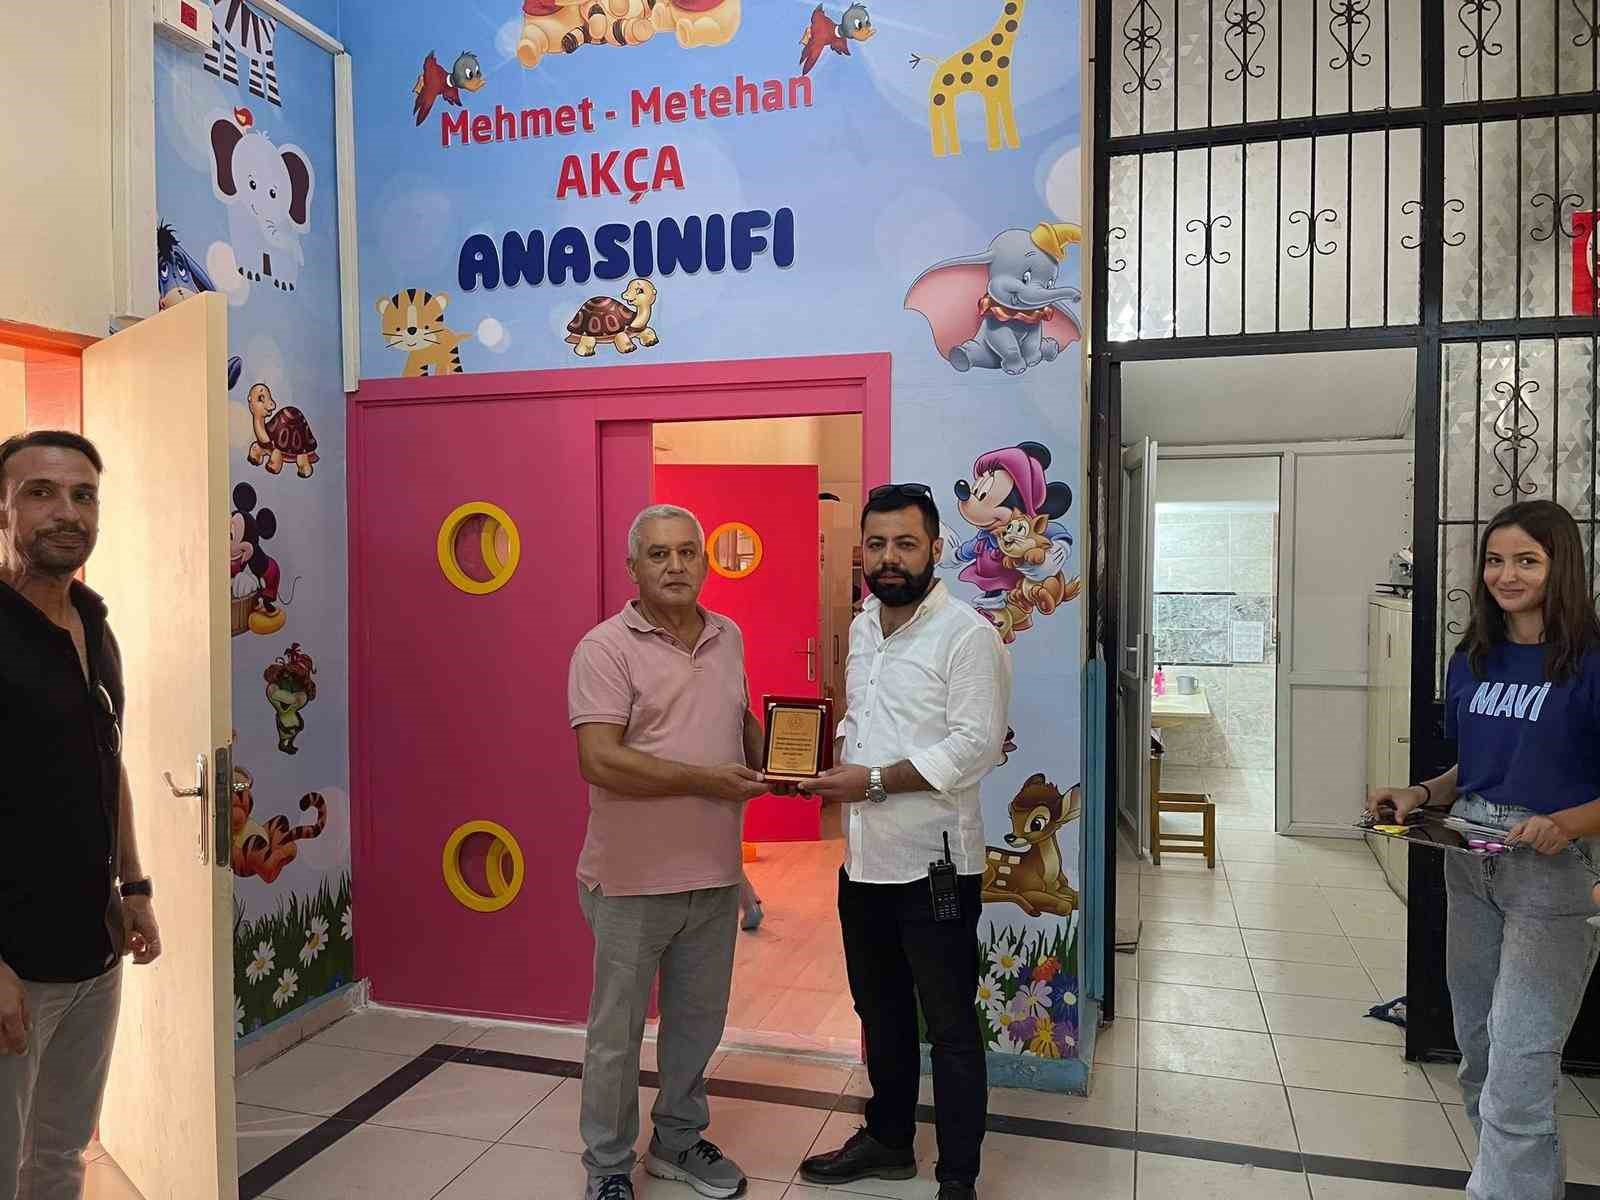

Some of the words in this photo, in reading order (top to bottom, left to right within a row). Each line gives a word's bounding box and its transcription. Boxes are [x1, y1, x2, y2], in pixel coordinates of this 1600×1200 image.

[440, 97, 594, 147] Mehmet
[631, 74, 813, 127] Metehan
[556, 145, 686, 204] AKÇA
[458, 207, 795, 292] ANASINIFI
[1469, 681, 1552, 722] MAVİ
